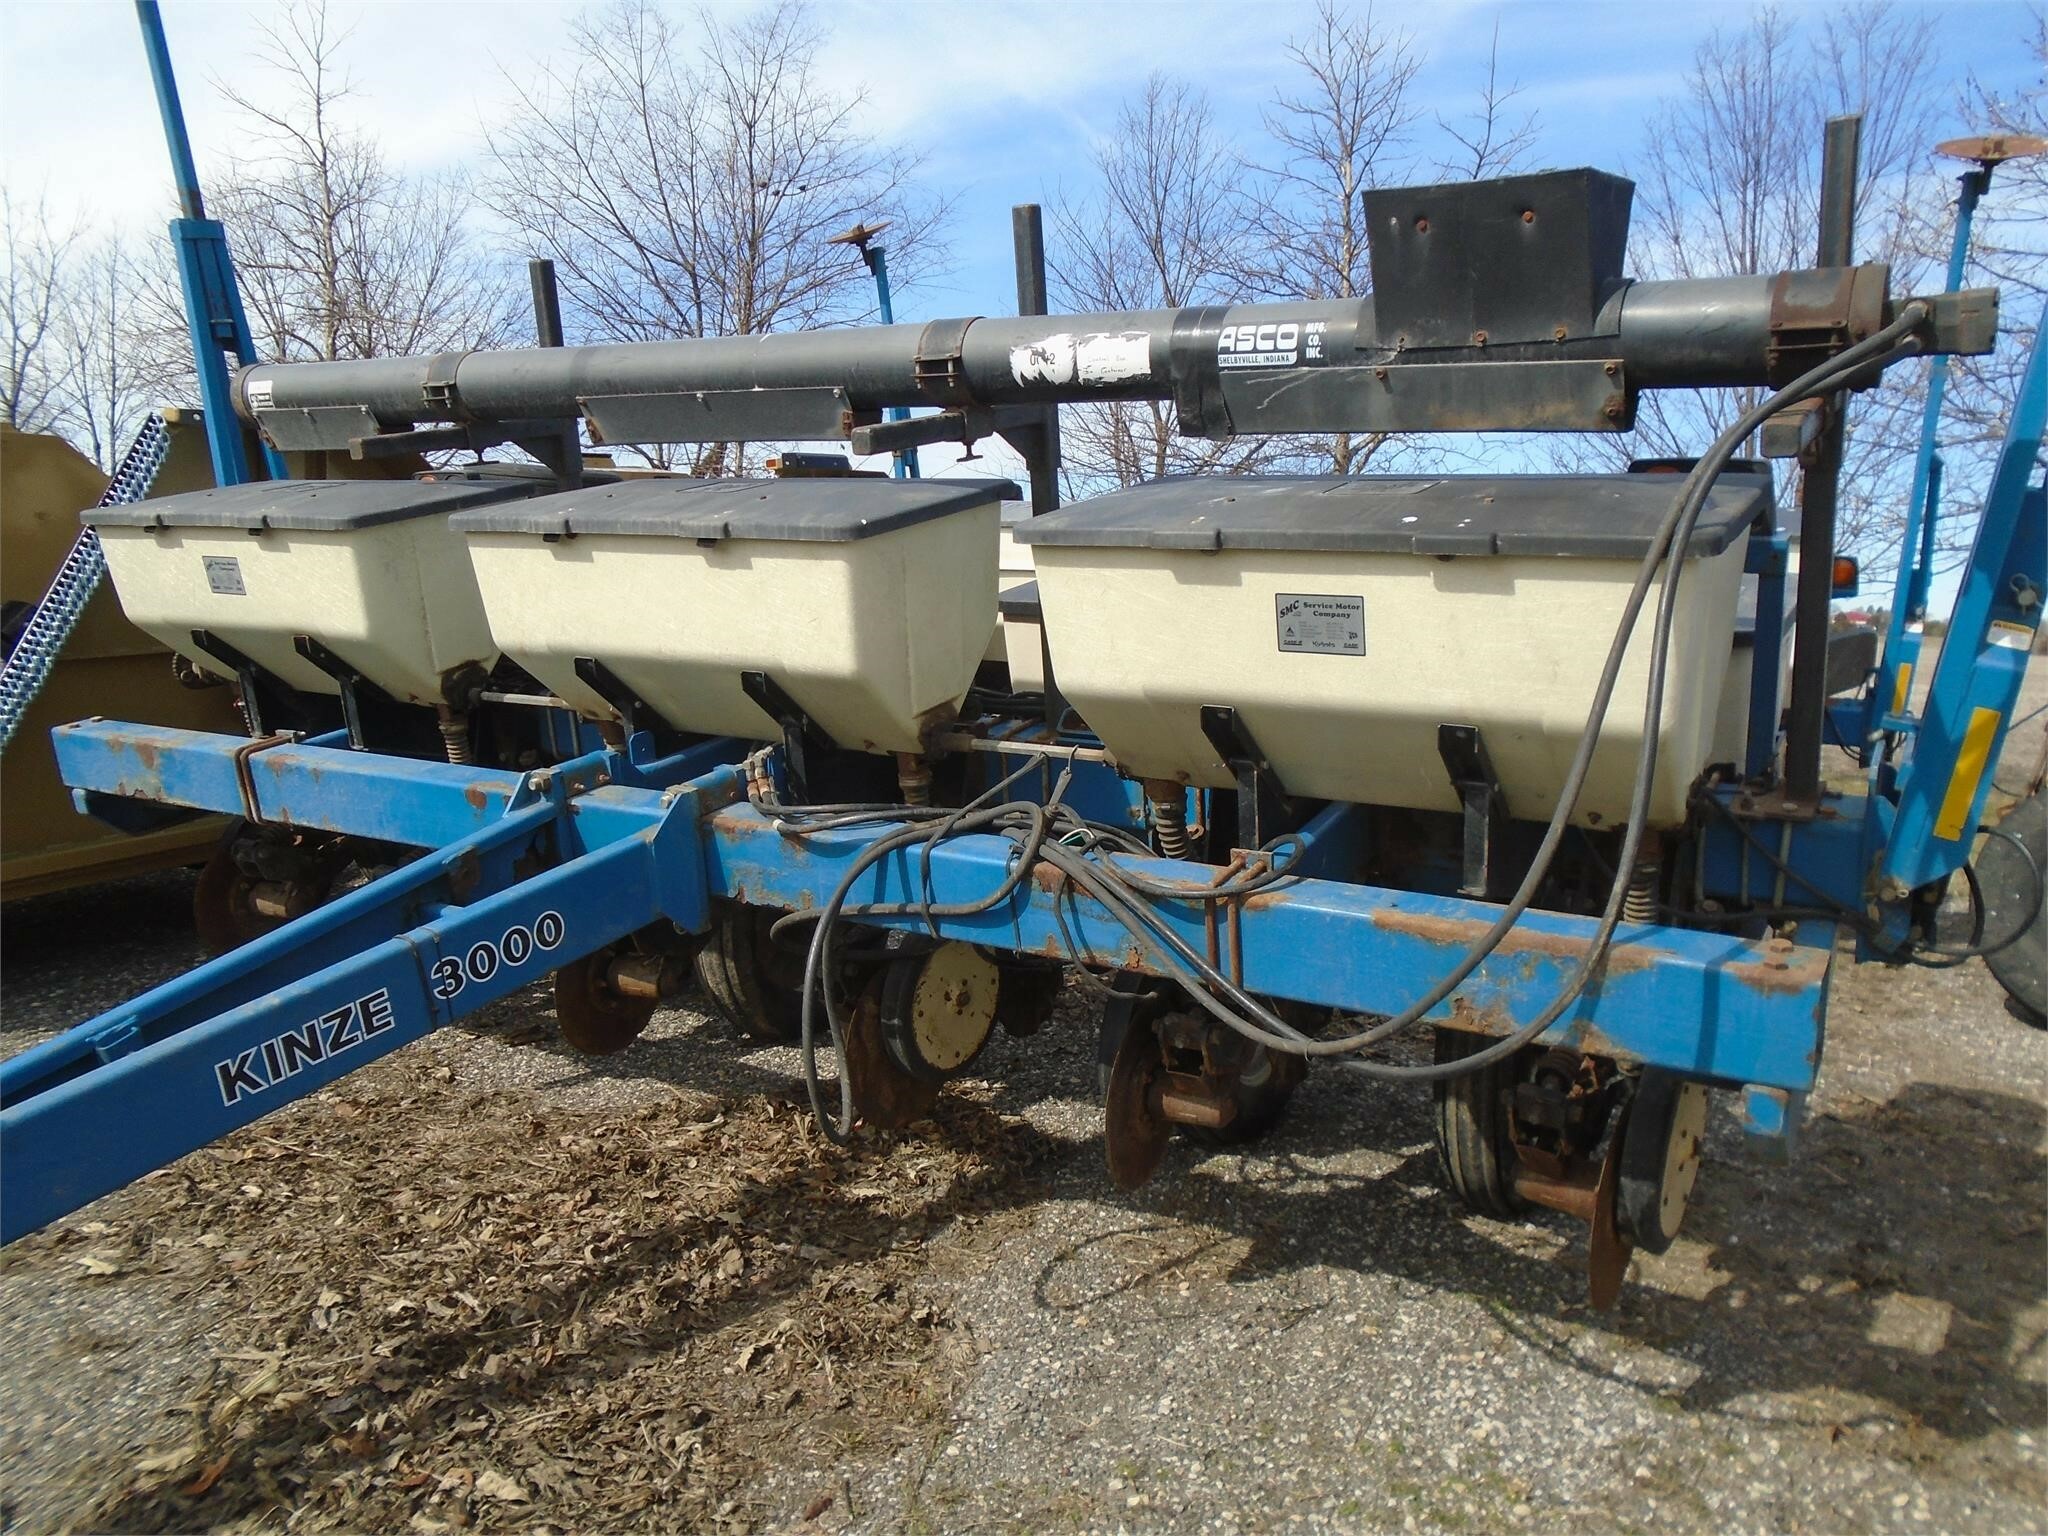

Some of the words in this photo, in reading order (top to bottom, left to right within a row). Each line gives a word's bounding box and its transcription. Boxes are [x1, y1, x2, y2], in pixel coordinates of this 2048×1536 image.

[1305, 322, 1327, 332] MFG.
[1218, 323, 1299, 351] ASCO
[1308, 334, 1321, 346] CO.
[1306, 347, 1323, 358] INC.
[1218, 355, 1261, 365] SHELBYVILLE,
[1263, 354, 1290, 363] INDIANA
[1280, 600, 1299, 618] SMC
[1313, 611, 1351, 619] Company
[214, 986, 395, 1107] KINZE
[430, 910, 565, 1000] 3000
